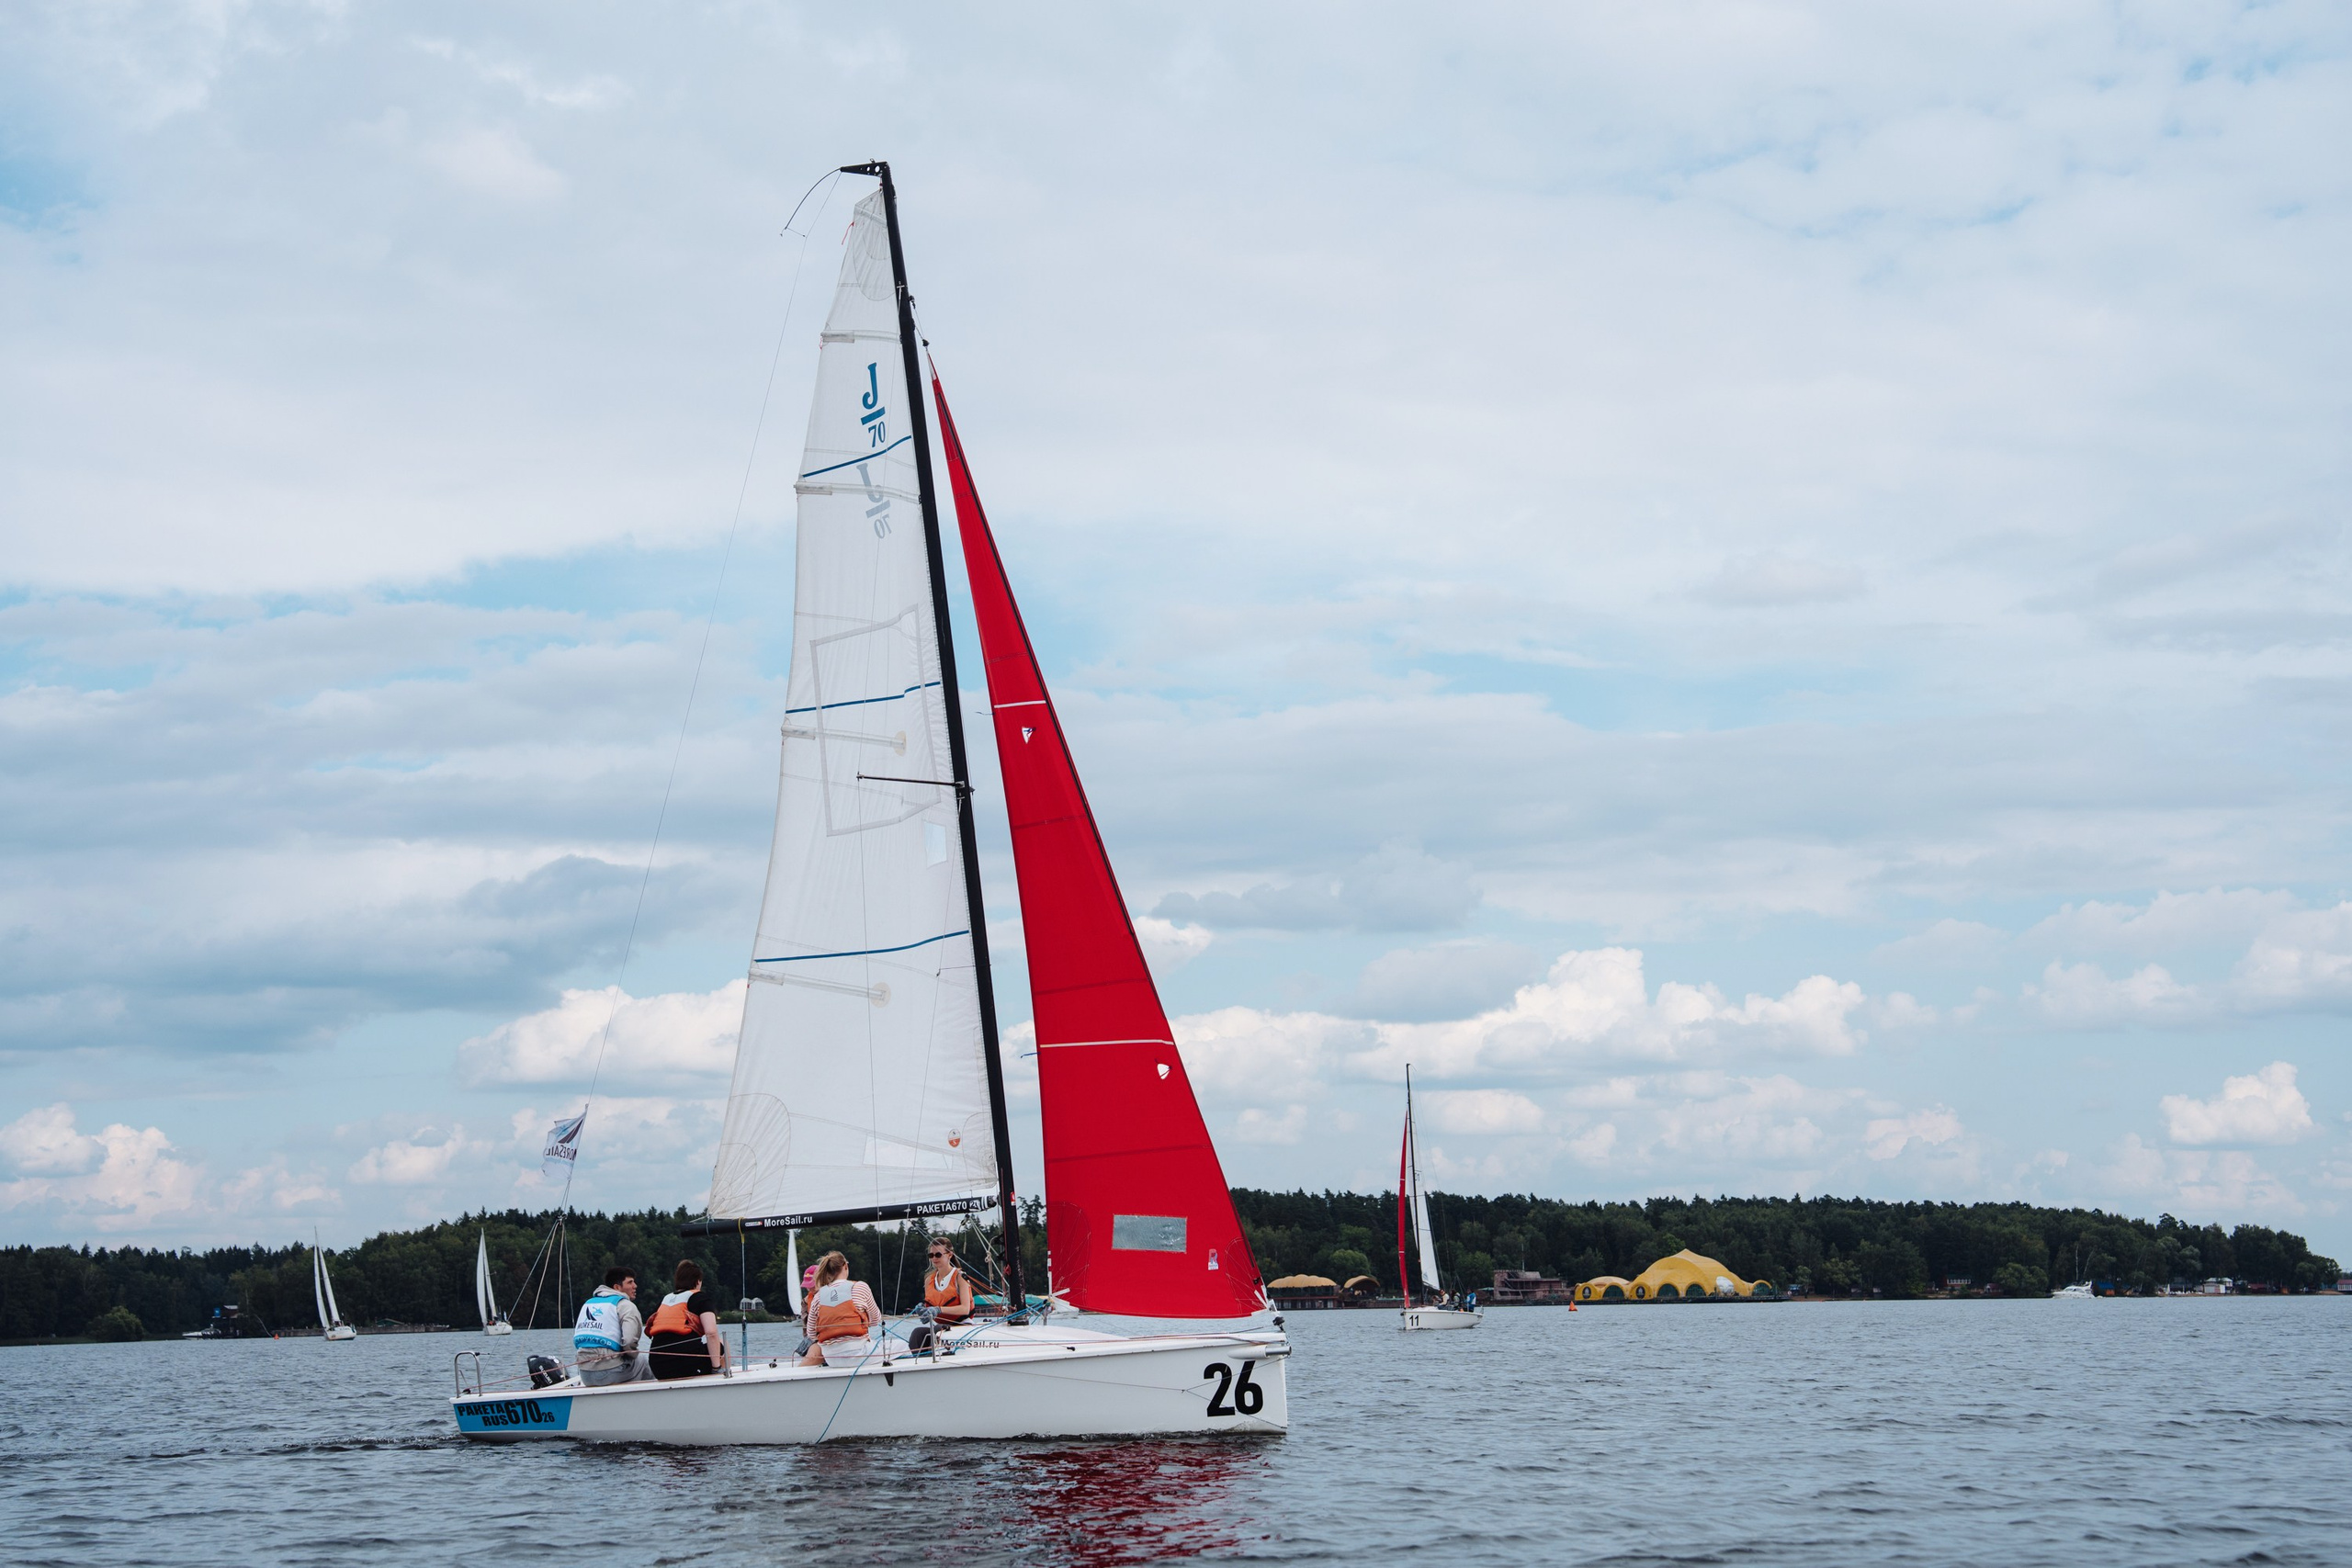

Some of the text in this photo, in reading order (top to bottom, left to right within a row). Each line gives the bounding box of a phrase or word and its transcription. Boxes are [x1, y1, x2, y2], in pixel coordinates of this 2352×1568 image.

[862, 362, 877, 410] J
[867, 421, 886, 447] 70
[763, 1215, 813, 1227] MoreSail.ru
[1408, 1314, 1419, 1326] 11
[1203, 1360, 1264, 1417] 26
[481, 1414, 509, 1427] RUS
[541, 1411, 555, 1423] 26
